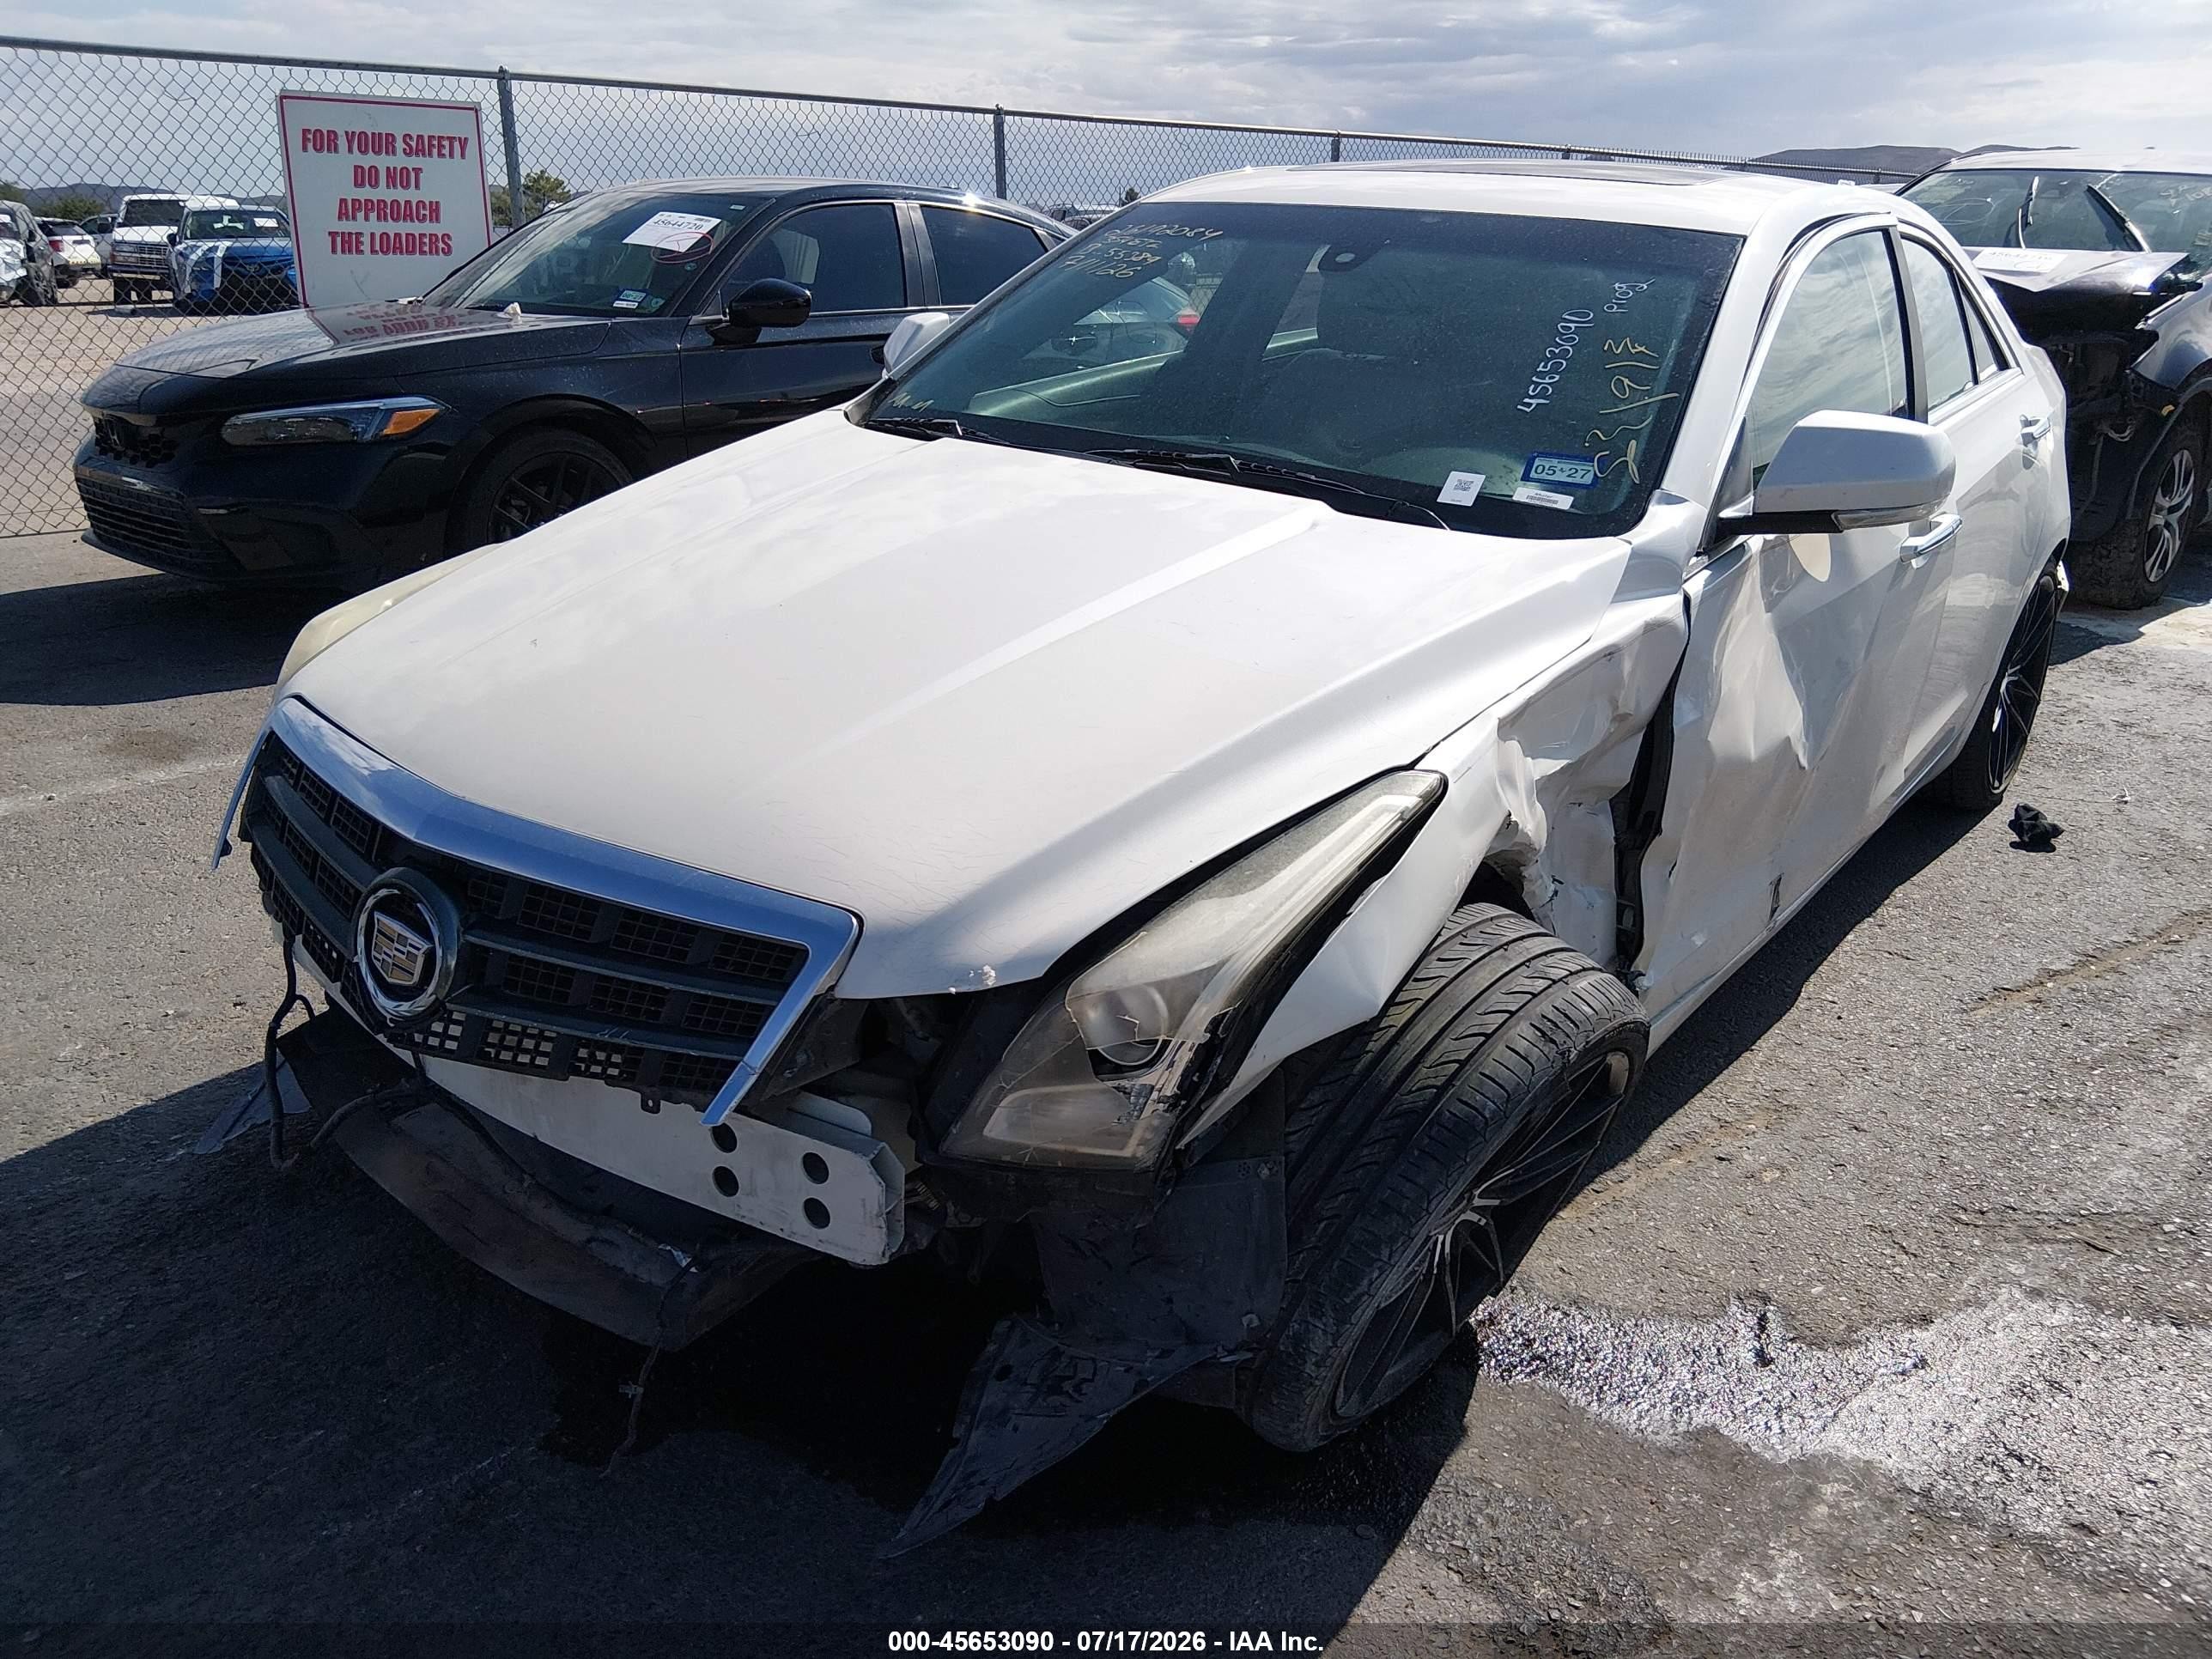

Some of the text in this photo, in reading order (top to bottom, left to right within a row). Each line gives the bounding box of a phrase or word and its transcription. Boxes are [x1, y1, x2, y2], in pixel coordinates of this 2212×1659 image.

[301, 128, 469, 160] FOR YOUR SAFETY
[353, 164, 422, 191] DO NOT
[337, 198, 441, 224] APPROACH
[328, 231, 453, 257] THE LOADERS
